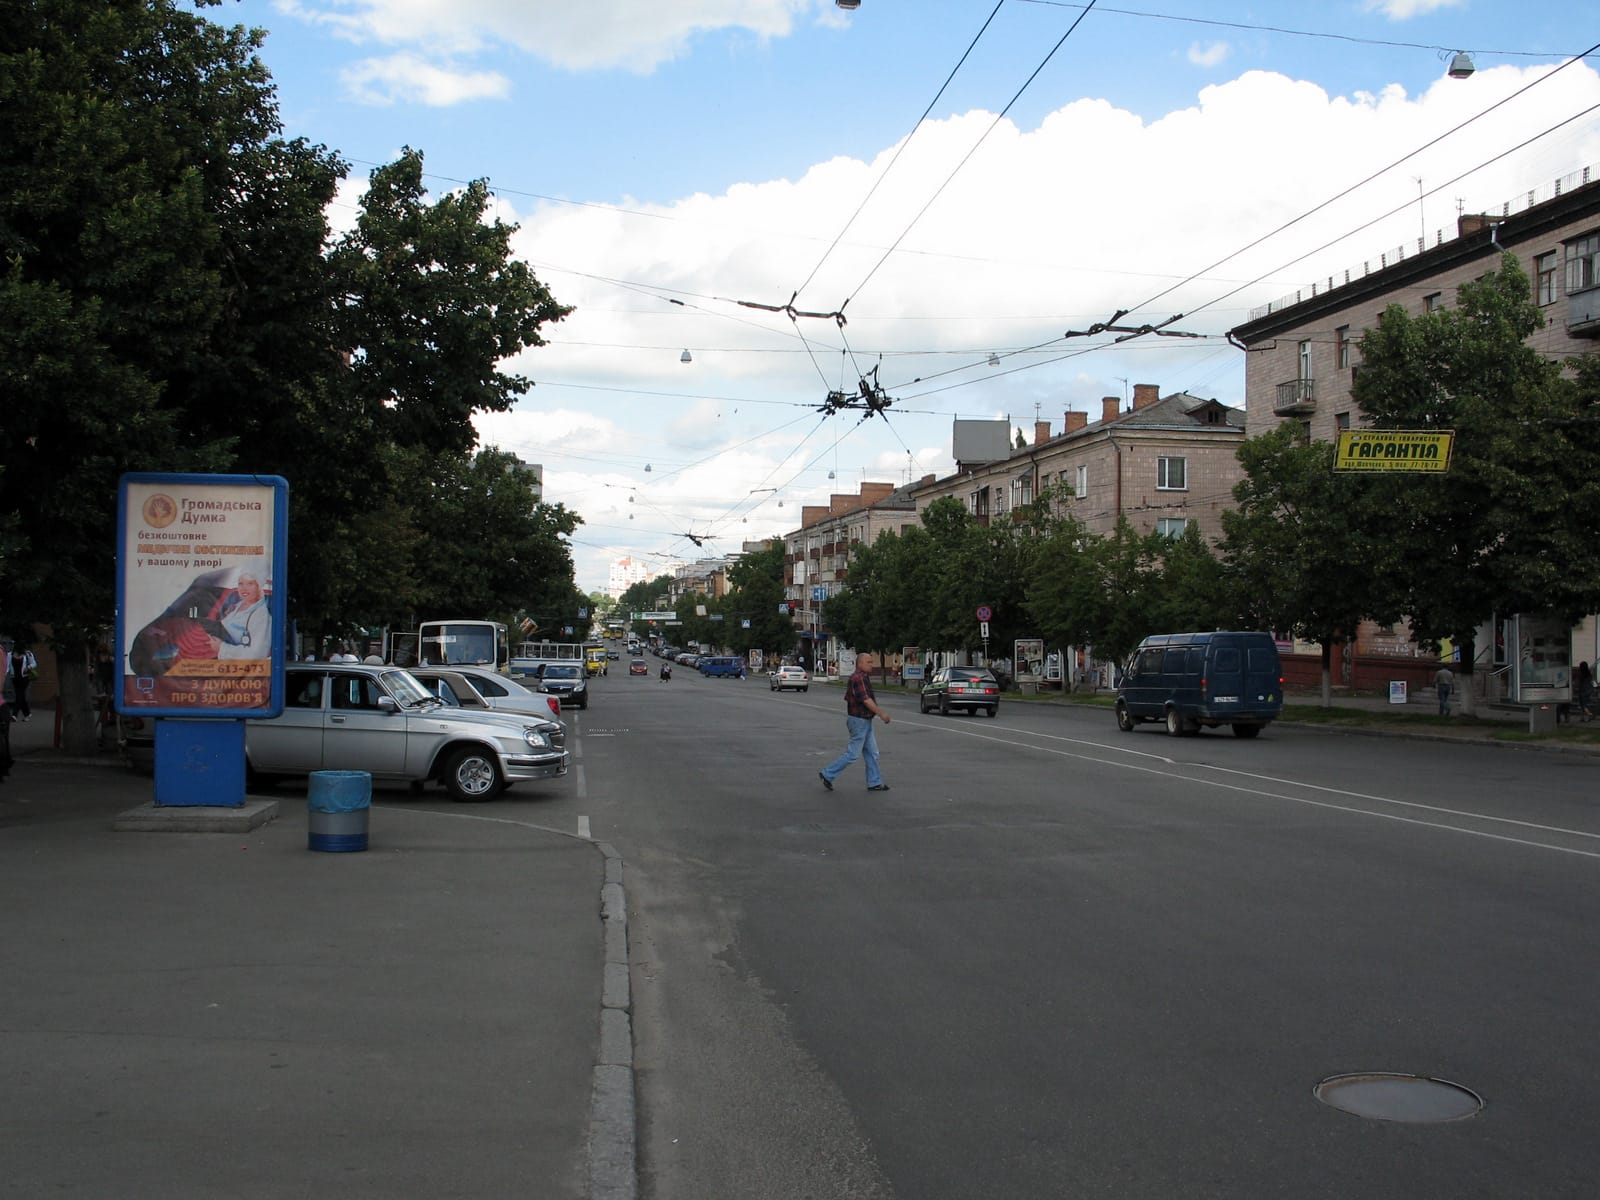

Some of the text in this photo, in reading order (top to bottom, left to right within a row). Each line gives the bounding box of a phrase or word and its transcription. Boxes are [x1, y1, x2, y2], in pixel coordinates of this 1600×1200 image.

[1348, 442, 1439, 459] ГАРАНТІЯ
[181, 498, 262, 511] Громадська
[181, 511, 226, 524] Думка
[138, 530, 207, 541] безкоштовне
[137, 559, 222, 568] у вашому дворі
[218, 664, 264, 673] 613-473
[203, 680, 262, 691] ДУМКОЮ
[172, 692, 263, 704] ПРО ЗДОРОВ'Я
